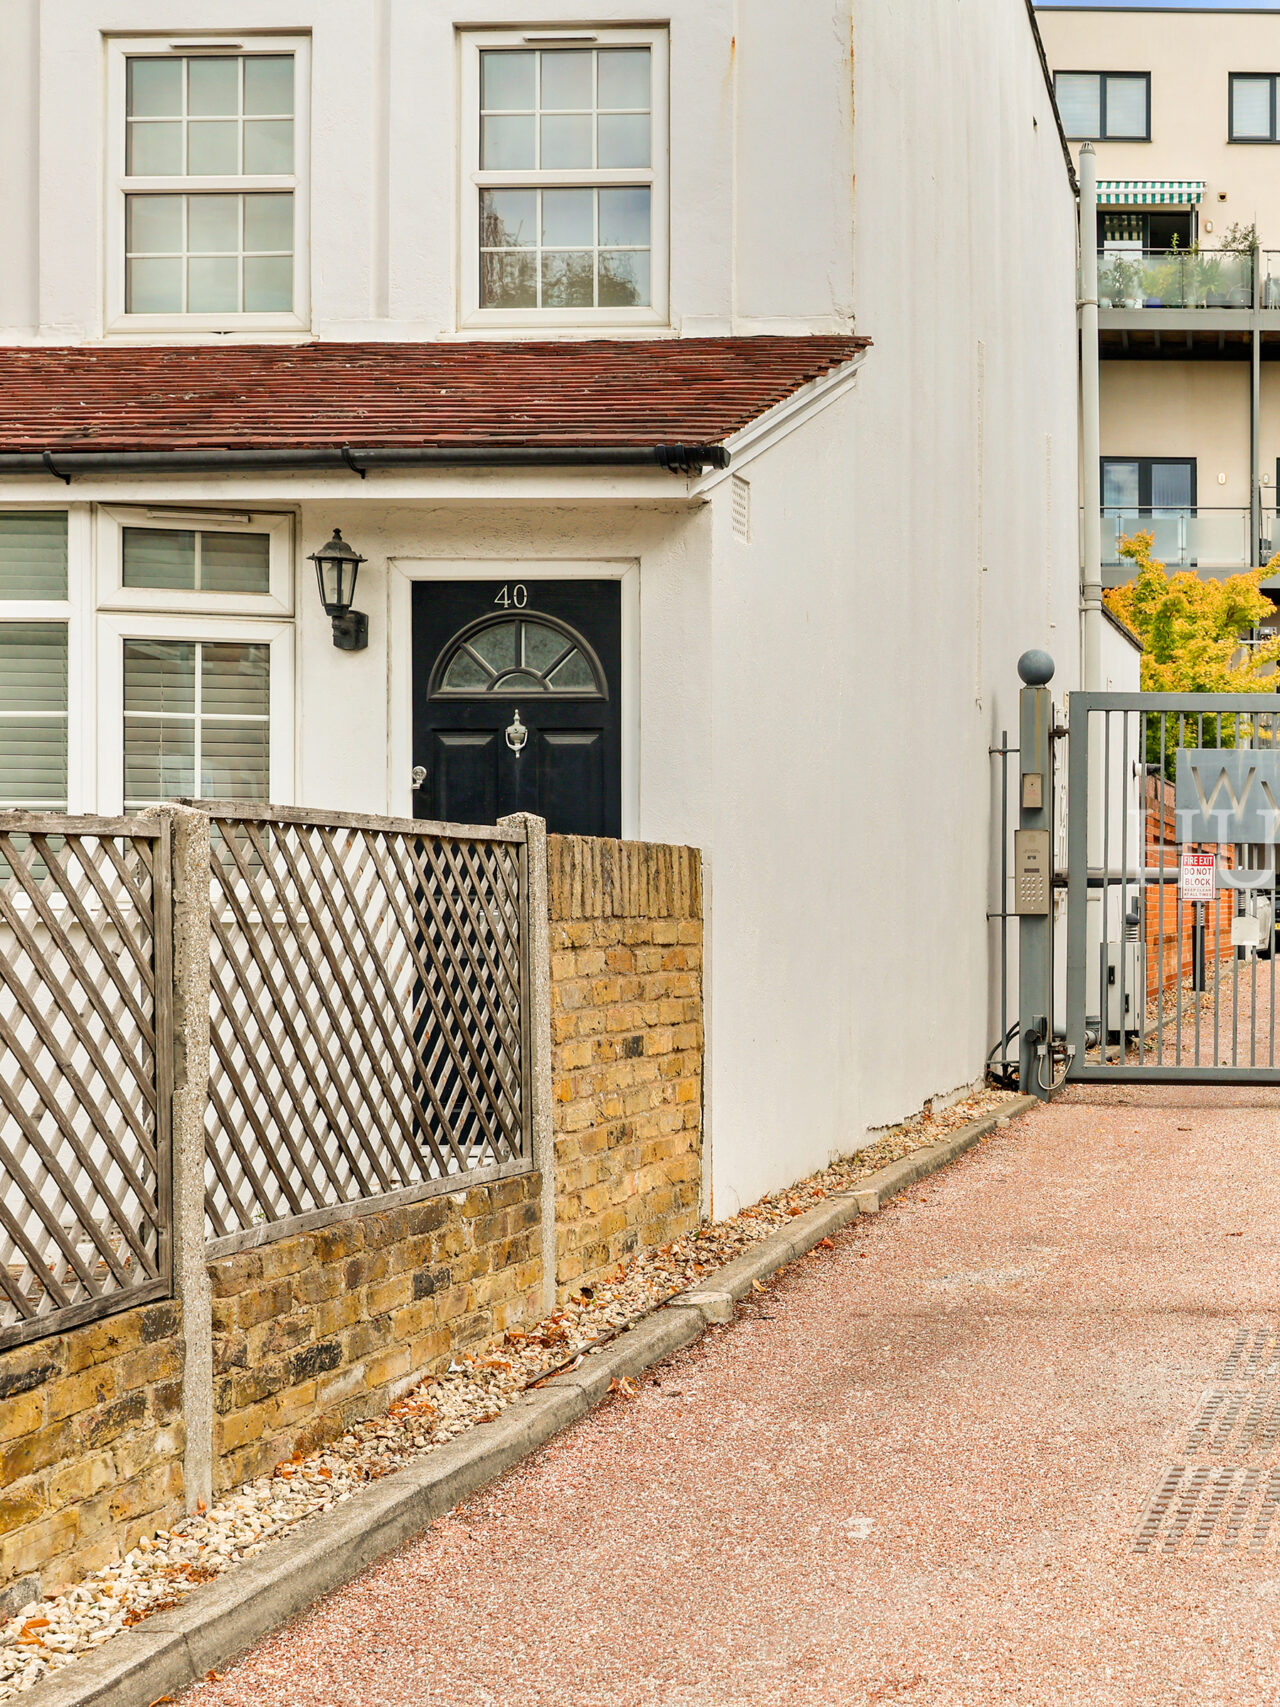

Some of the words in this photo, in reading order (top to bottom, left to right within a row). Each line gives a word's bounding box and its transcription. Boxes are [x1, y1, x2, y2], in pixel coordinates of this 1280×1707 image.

[493, 584, 528, 608] 40
[1184, 856, 1198, 864] FIRE
[1199, 856, 1213, 864] EXIT
[1185, 878, 1211, 886] BLOCK
